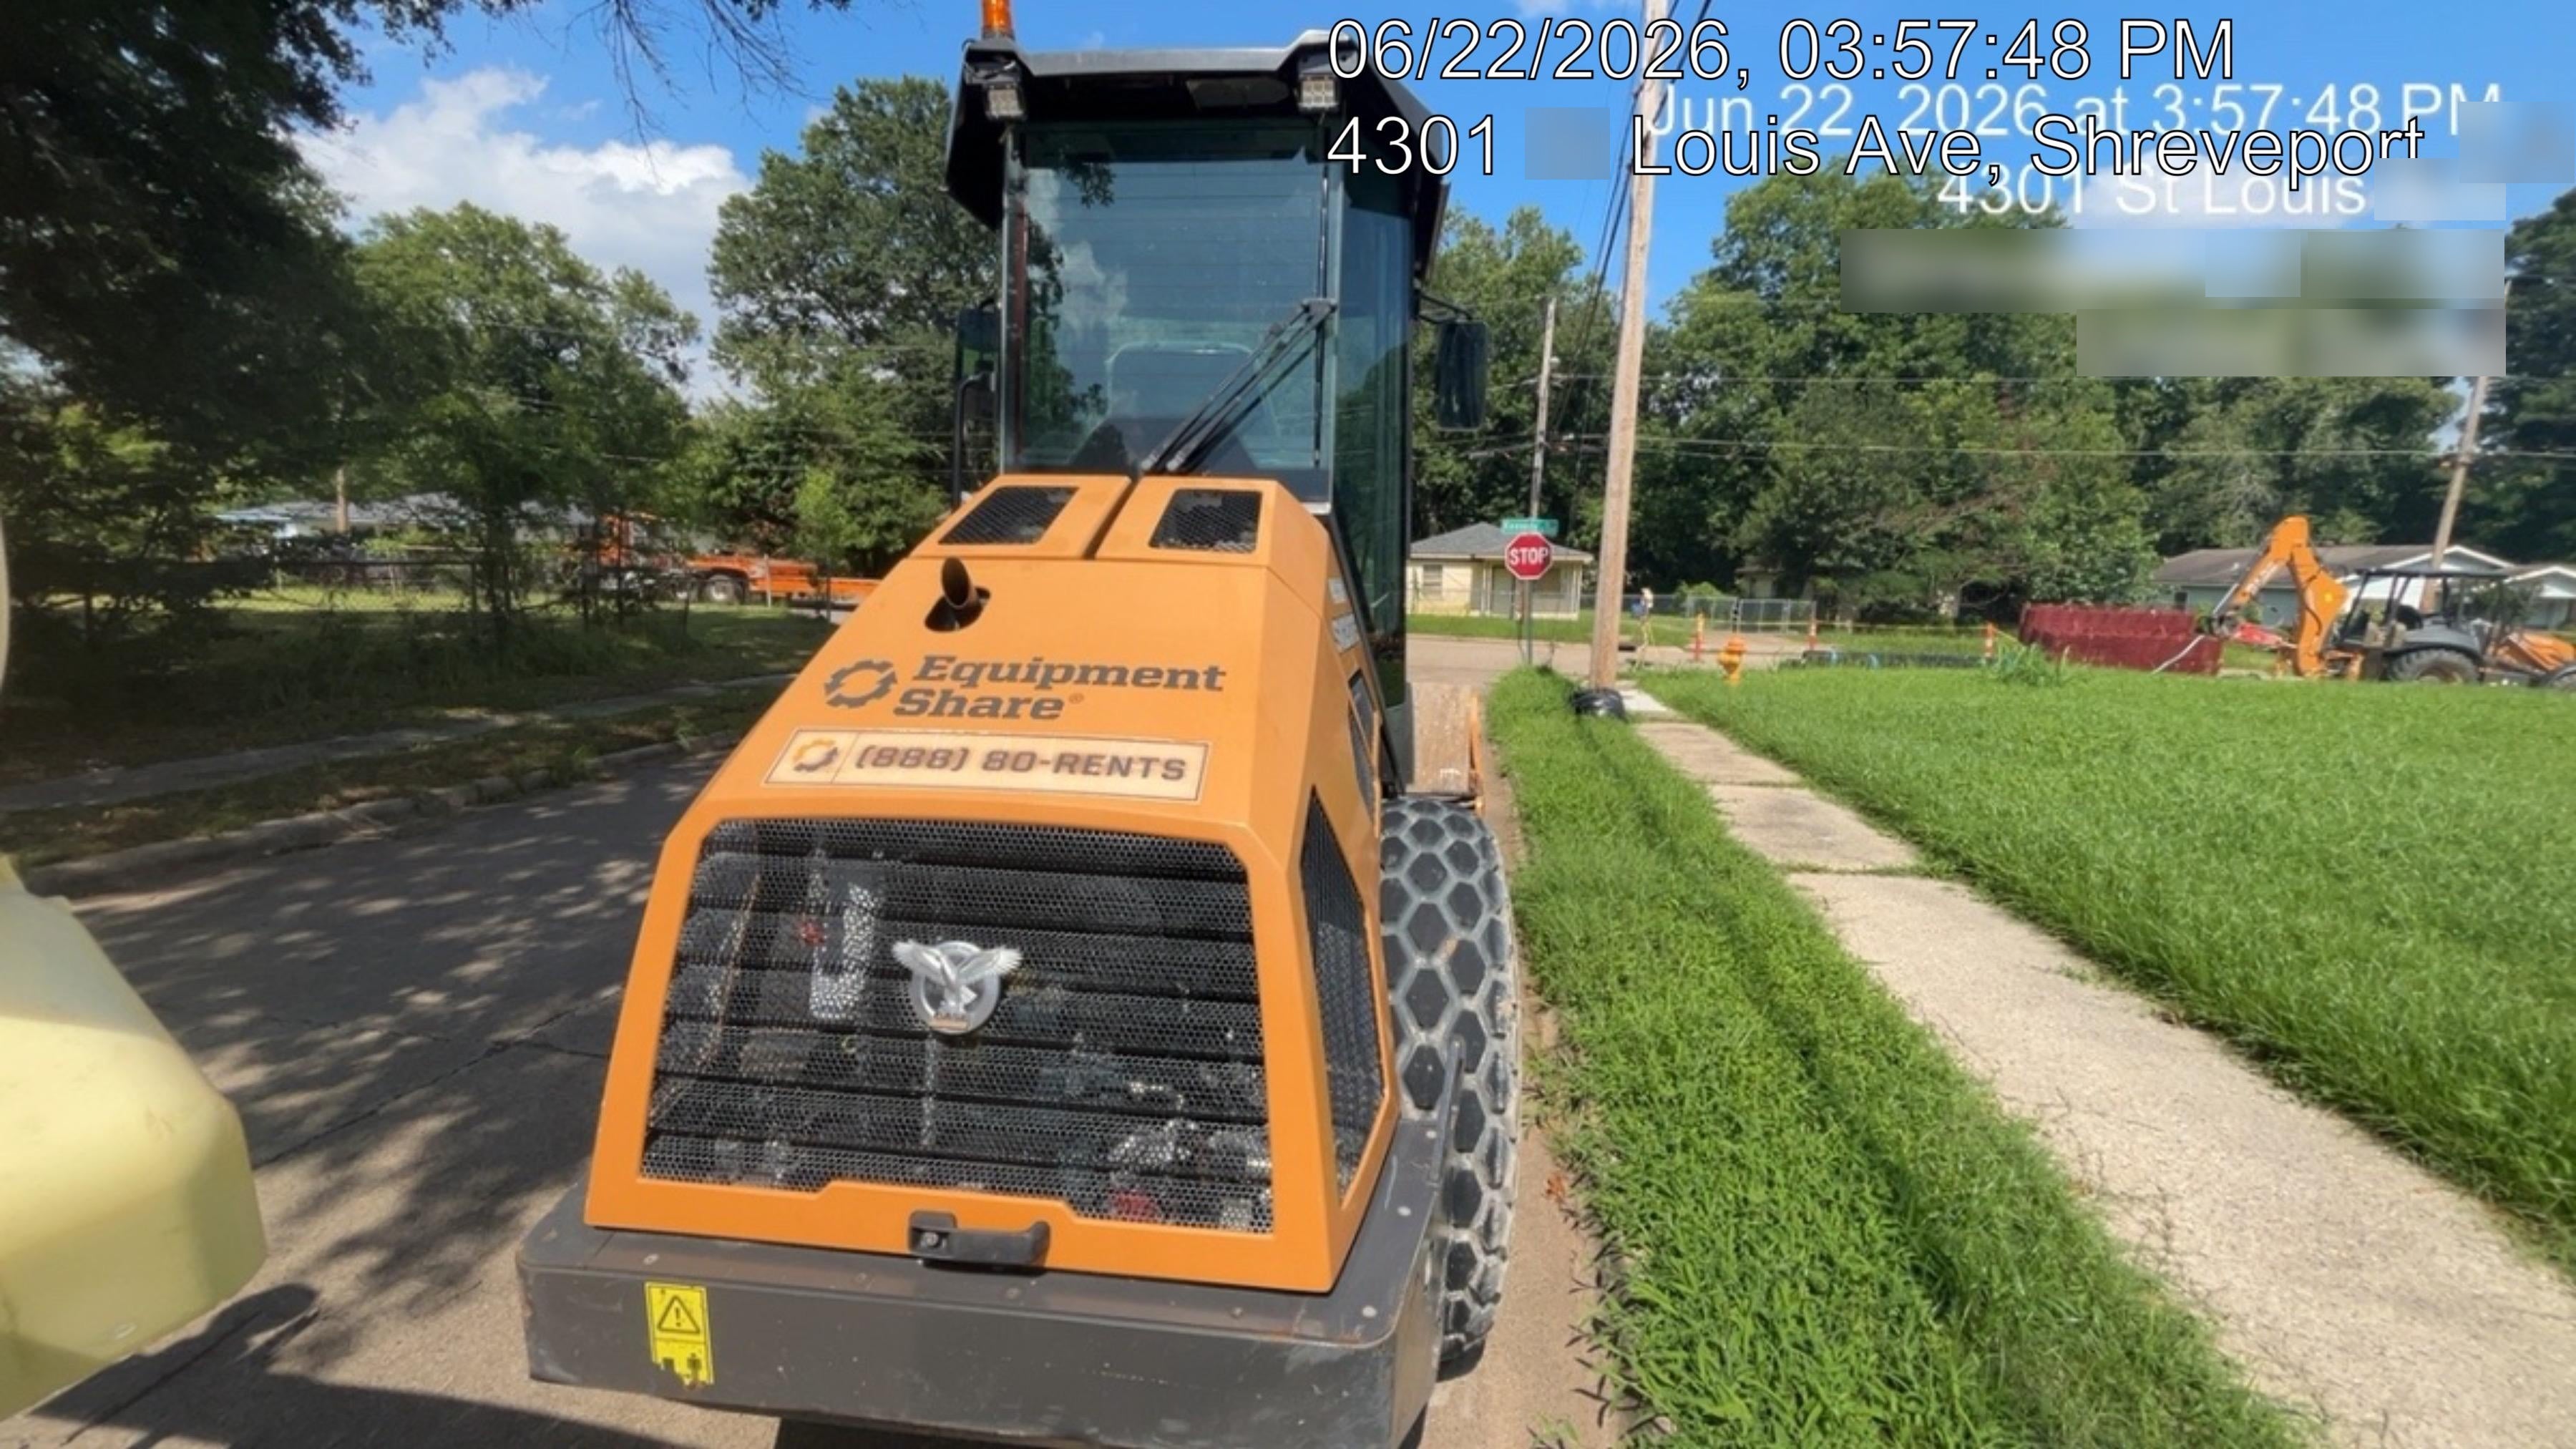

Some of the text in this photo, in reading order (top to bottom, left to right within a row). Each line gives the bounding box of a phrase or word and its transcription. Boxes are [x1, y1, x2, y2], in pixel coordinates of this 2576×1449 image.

[1509, 547, 1548, 565] STOP
[912, 655, 1227, 691] Equipment
[856, 745, 1186, 781] (888) 80-RENTS
